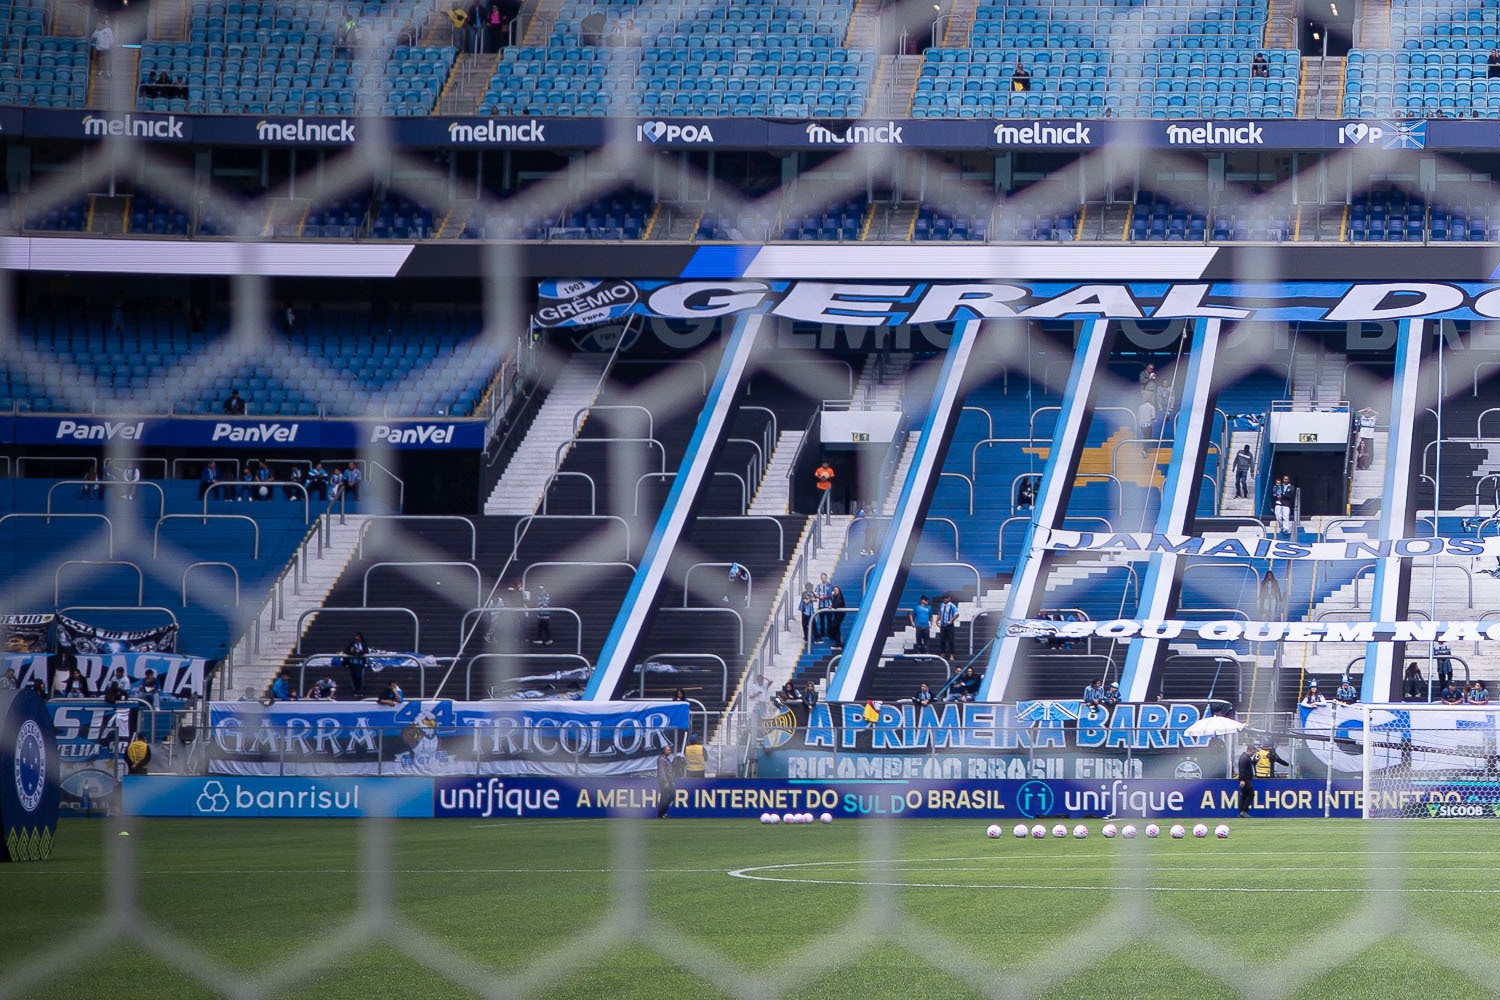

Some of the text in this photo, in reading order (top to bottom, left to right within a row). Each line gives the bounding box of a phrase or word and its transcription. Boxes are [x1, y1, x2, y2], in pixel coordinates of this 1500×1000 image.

[83, 114, 183, 138] melnick
[257, 119, 355, 142] melnick
[449, 119, 545, 142] melnick
[667, 125, 713, 143] POA
[994, 121, 1090, 144] melnick
[1167, 121, 1263, 144] melnick
[539, 284, 630, 321] GRÊMIO
[647, 280, 1251, 325] GERAL
[56, 421, 144, 440] PanVel
[212, 423, 298, 442] PanVel
[370, 425, 454, 444] PanVel
[1054, 532, 1313, 558] JAMAIS
[1344, 536, 1486, 558] NOS
[1197, 620, 1384, 642] QUEM
[214, 716, 377, 757] GARRA
[463, 712, 674, 758] TRICOLOR
[805, 702, 836, 748] A
[236, 784, 359, 809] banrisul
[576, 789, 588, 808] A
[694, 789, 802, 809] INTERNET
[806, 789, 839, 809] DO
[843, 794, 887, 815] SUL
[928, 790, 1005, 810] BRASIL
[1200, 791, 1216, 809] A
[1221, 790, 1312, 810] MLHOR
[1440, 804, 1483, 816] SICOOB
